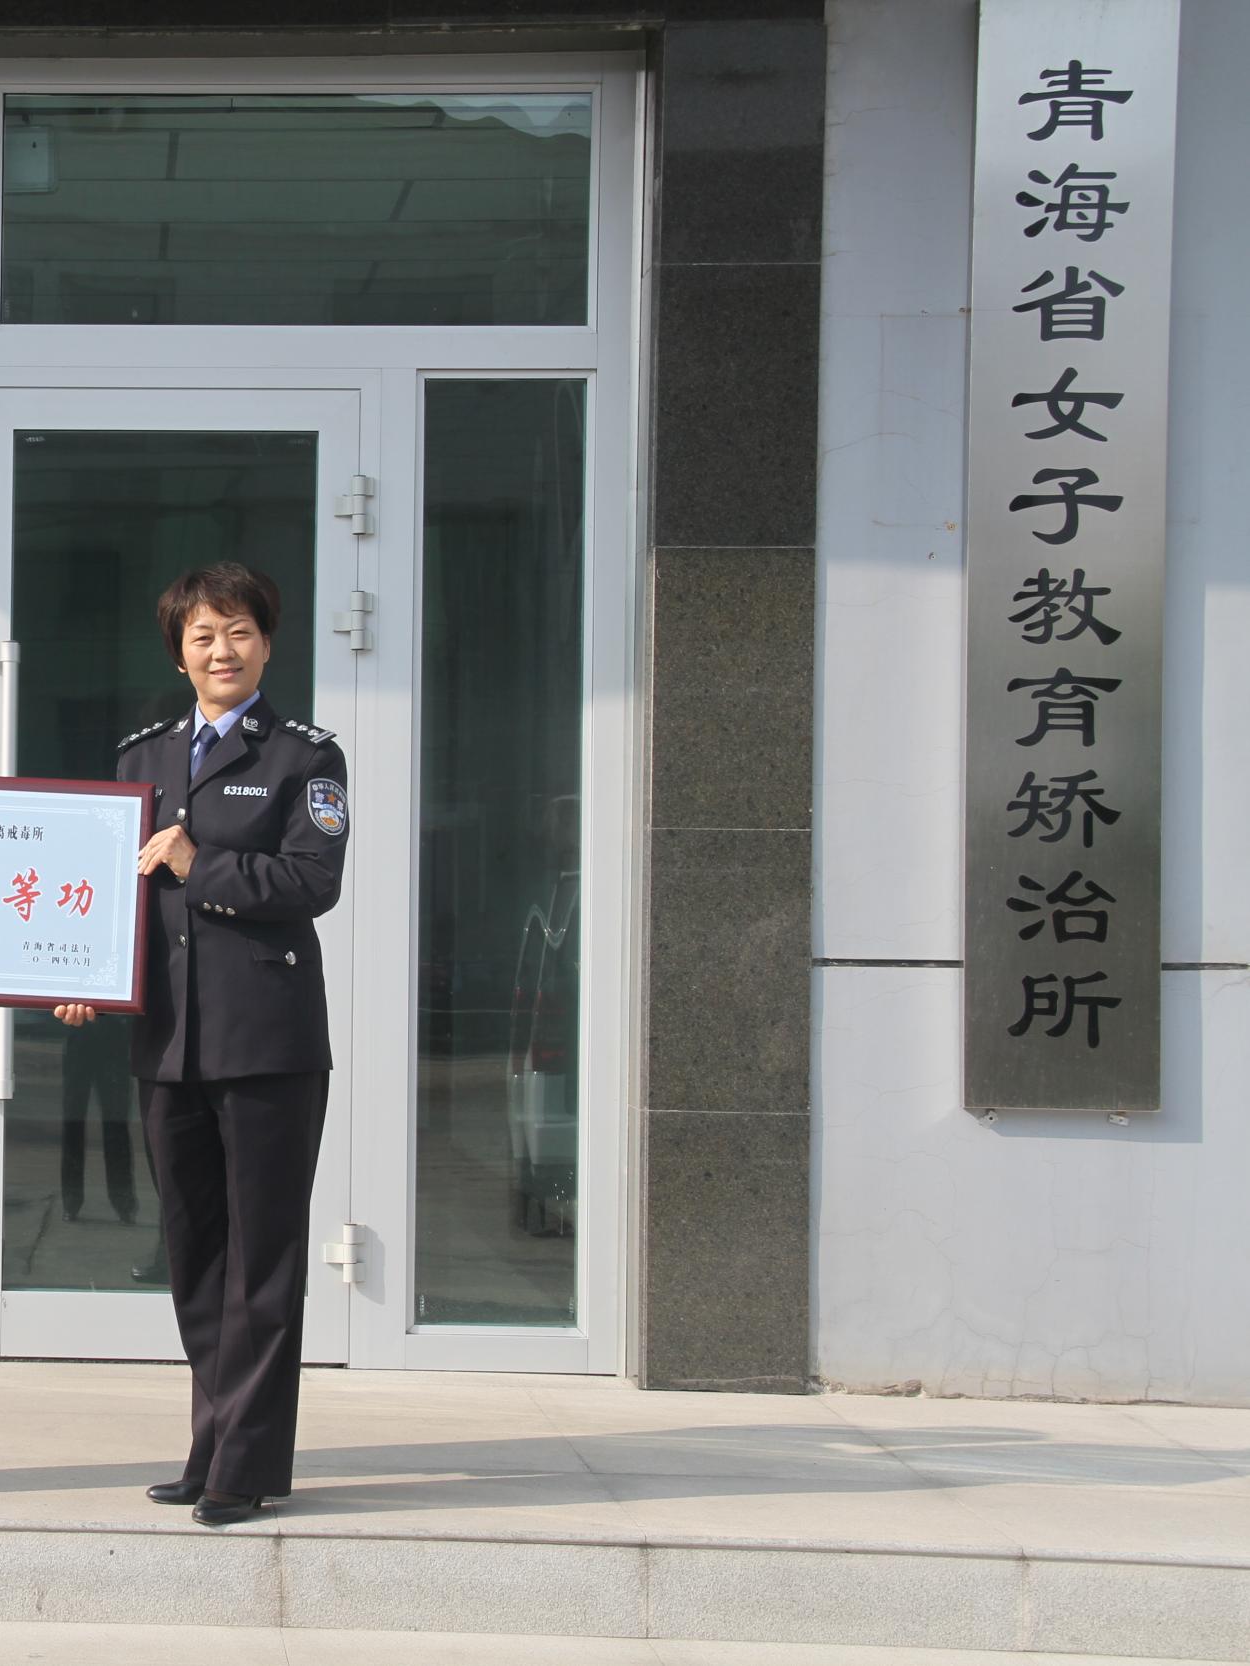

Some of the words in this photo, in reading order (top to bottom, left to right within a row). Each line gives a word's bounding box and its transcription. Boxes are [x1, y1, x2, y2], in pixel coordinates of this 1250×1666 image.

[223, 785, 268, 797] 6318001
[1006, 59, 1134, 1049] 青海省女子教育矫治所
